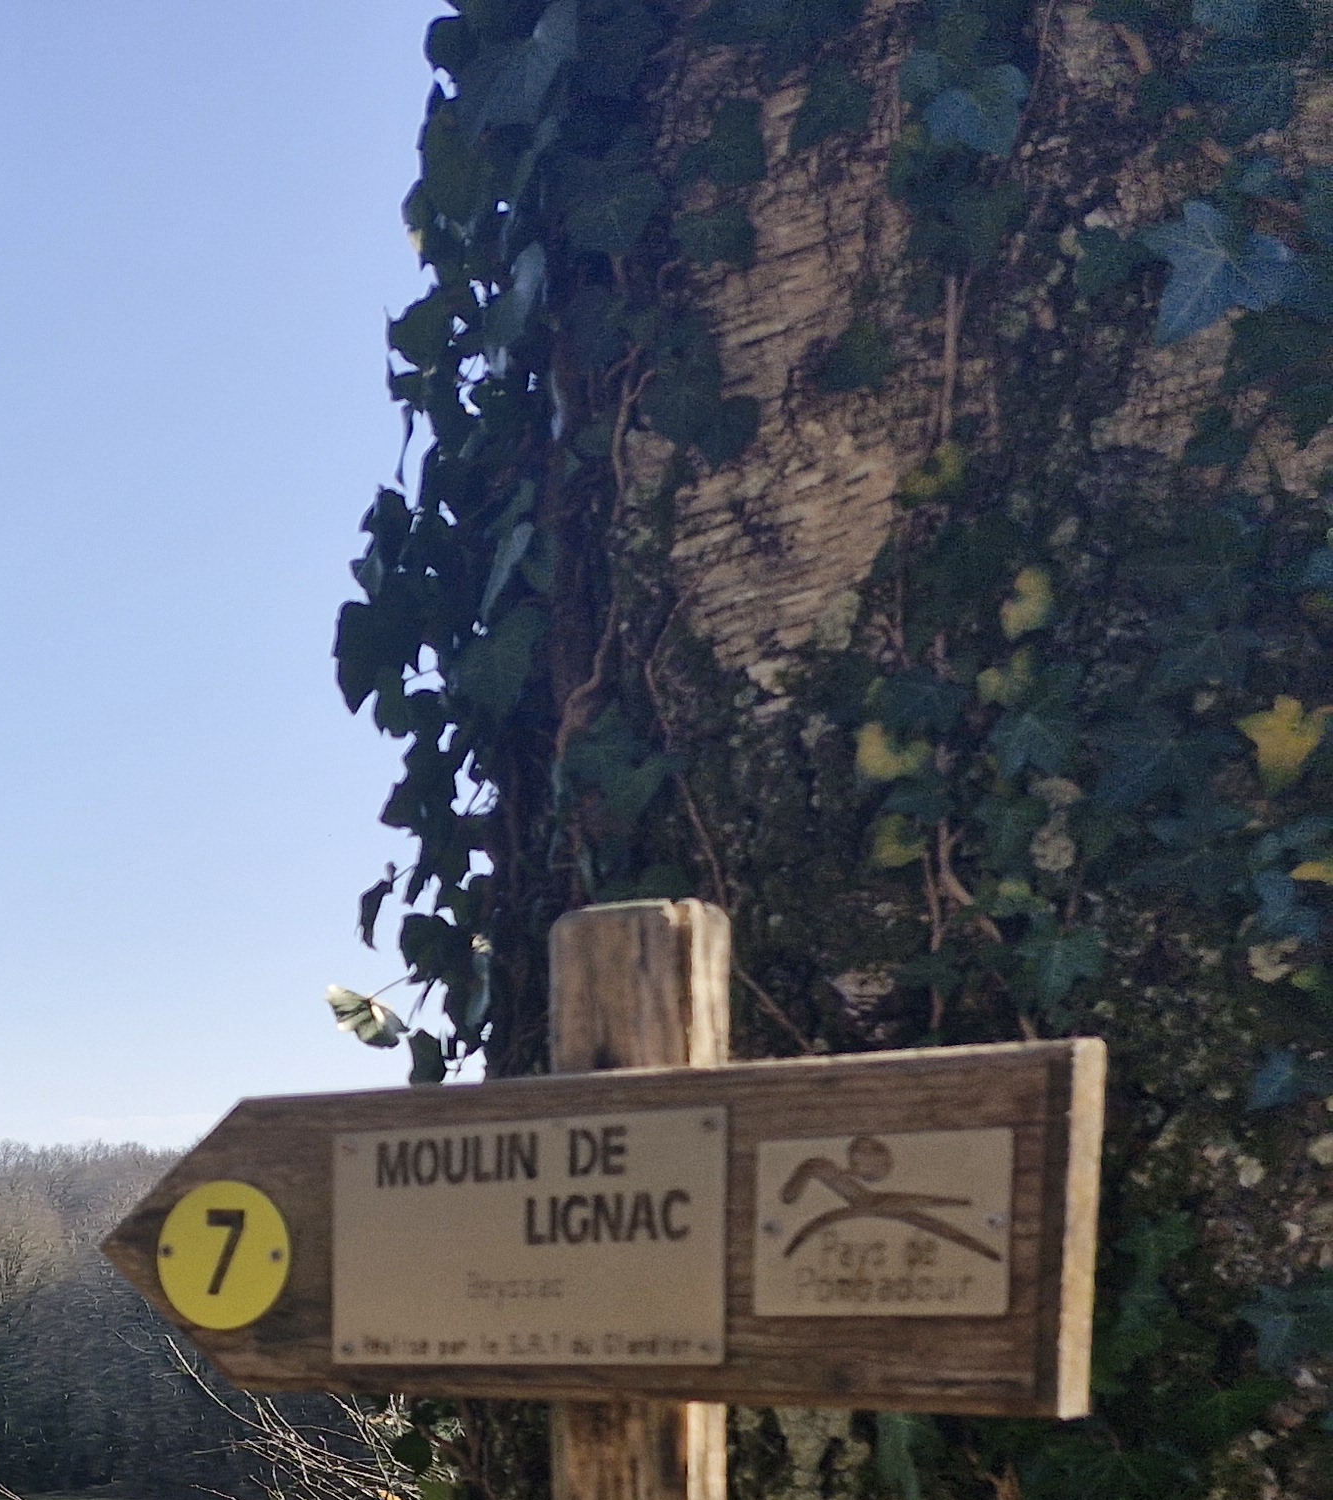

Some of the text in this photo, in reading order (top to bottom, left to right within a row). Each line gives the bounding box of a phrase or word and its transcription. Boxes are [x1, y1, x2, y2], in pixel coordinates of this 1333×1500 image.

[376, 1125, 627, 1188] MOULIN DE
[524, 1188, 691, 1245] LIGNAC
[206, 1208, 245, 1295] 7
